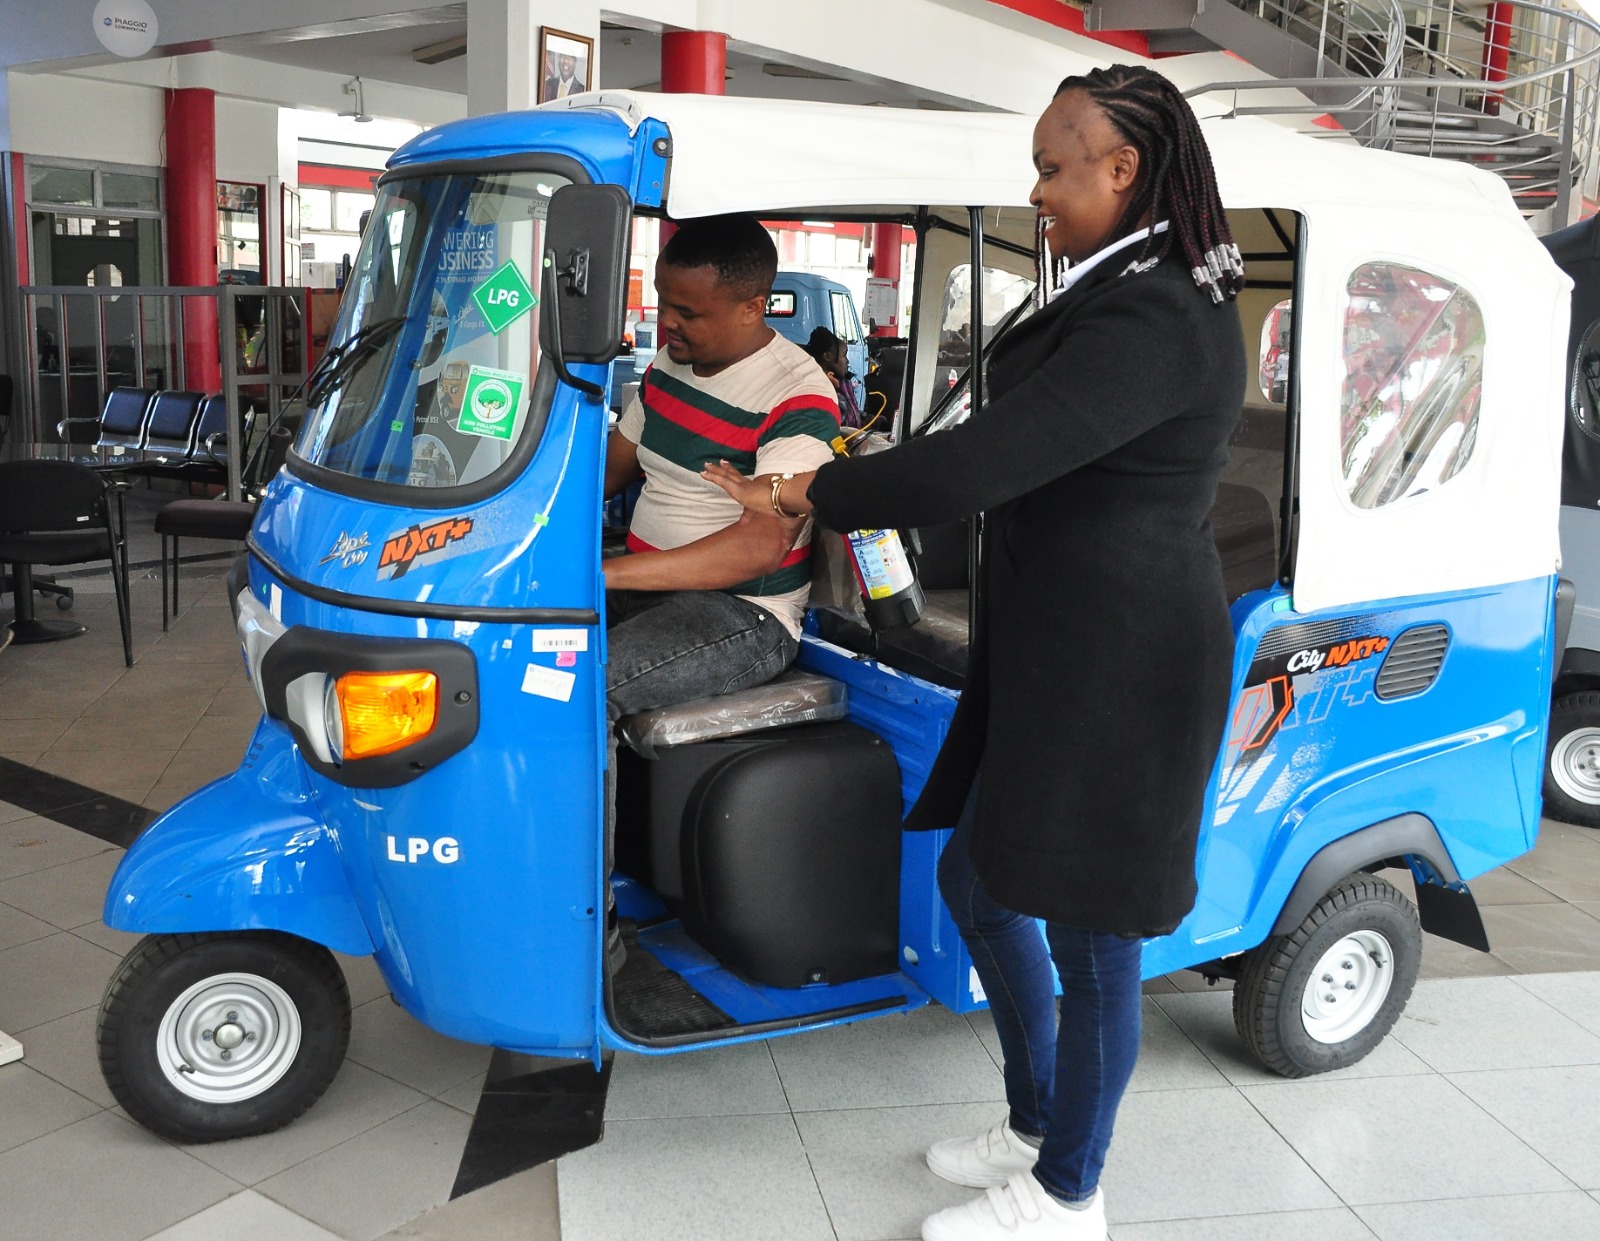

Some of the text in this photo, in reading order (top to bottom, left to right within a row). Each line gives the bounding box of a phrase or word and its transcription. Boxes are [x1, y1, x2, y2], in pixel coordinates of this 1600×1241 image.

[114, 18, 148, 29] PIAGGIO
[443, 231, 494, 249] WERING
[438, 250, 494, 271] USINESS
[487, 288, 520, 307] LPG
[378, 519, 473, 568] NXT+
[1287, 638, 1388, 672] City NXT+
[387, 835, 459, 864] LPG
